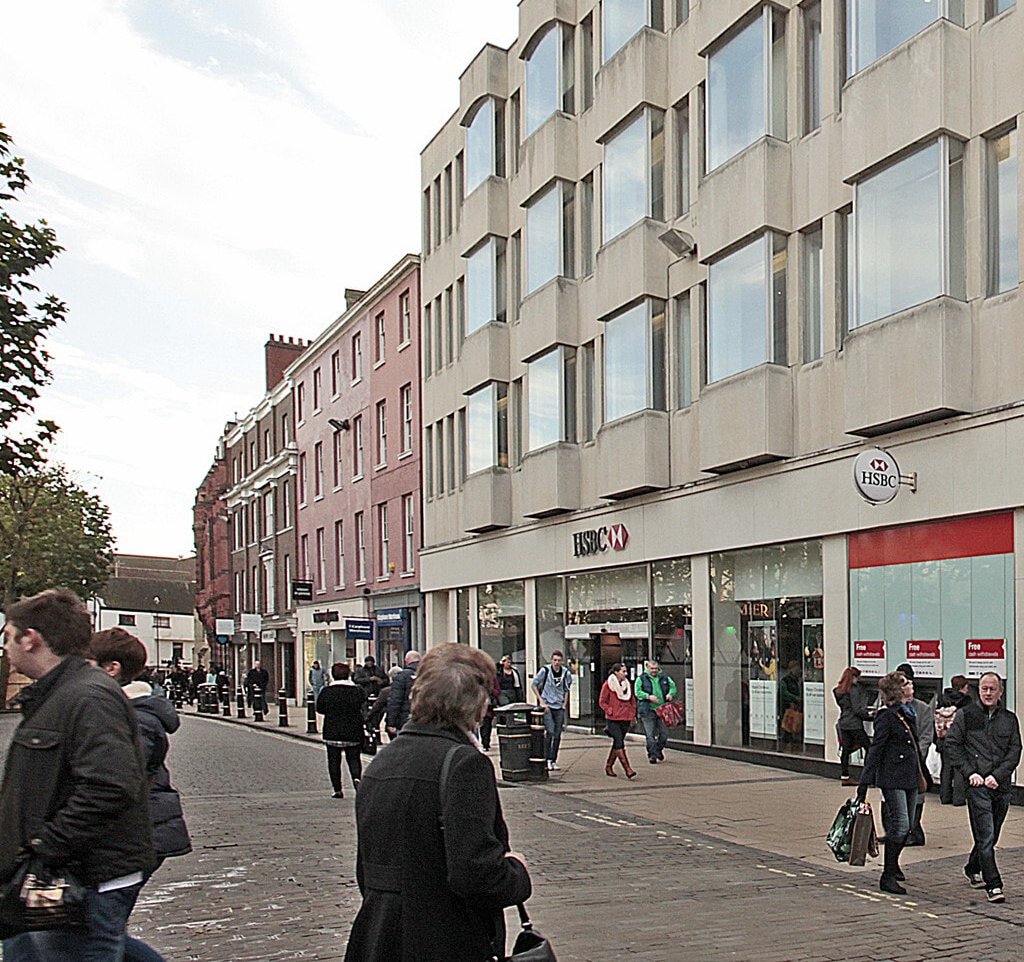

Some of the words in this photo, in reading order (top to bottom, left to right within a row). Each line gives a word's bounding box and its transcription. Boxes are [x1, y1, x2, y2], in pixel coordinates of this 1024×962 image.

[861, 471, 897, 488] HSBC
[572, 526, 608, 557] HSBC
[968, 642, 981, 650] Free
